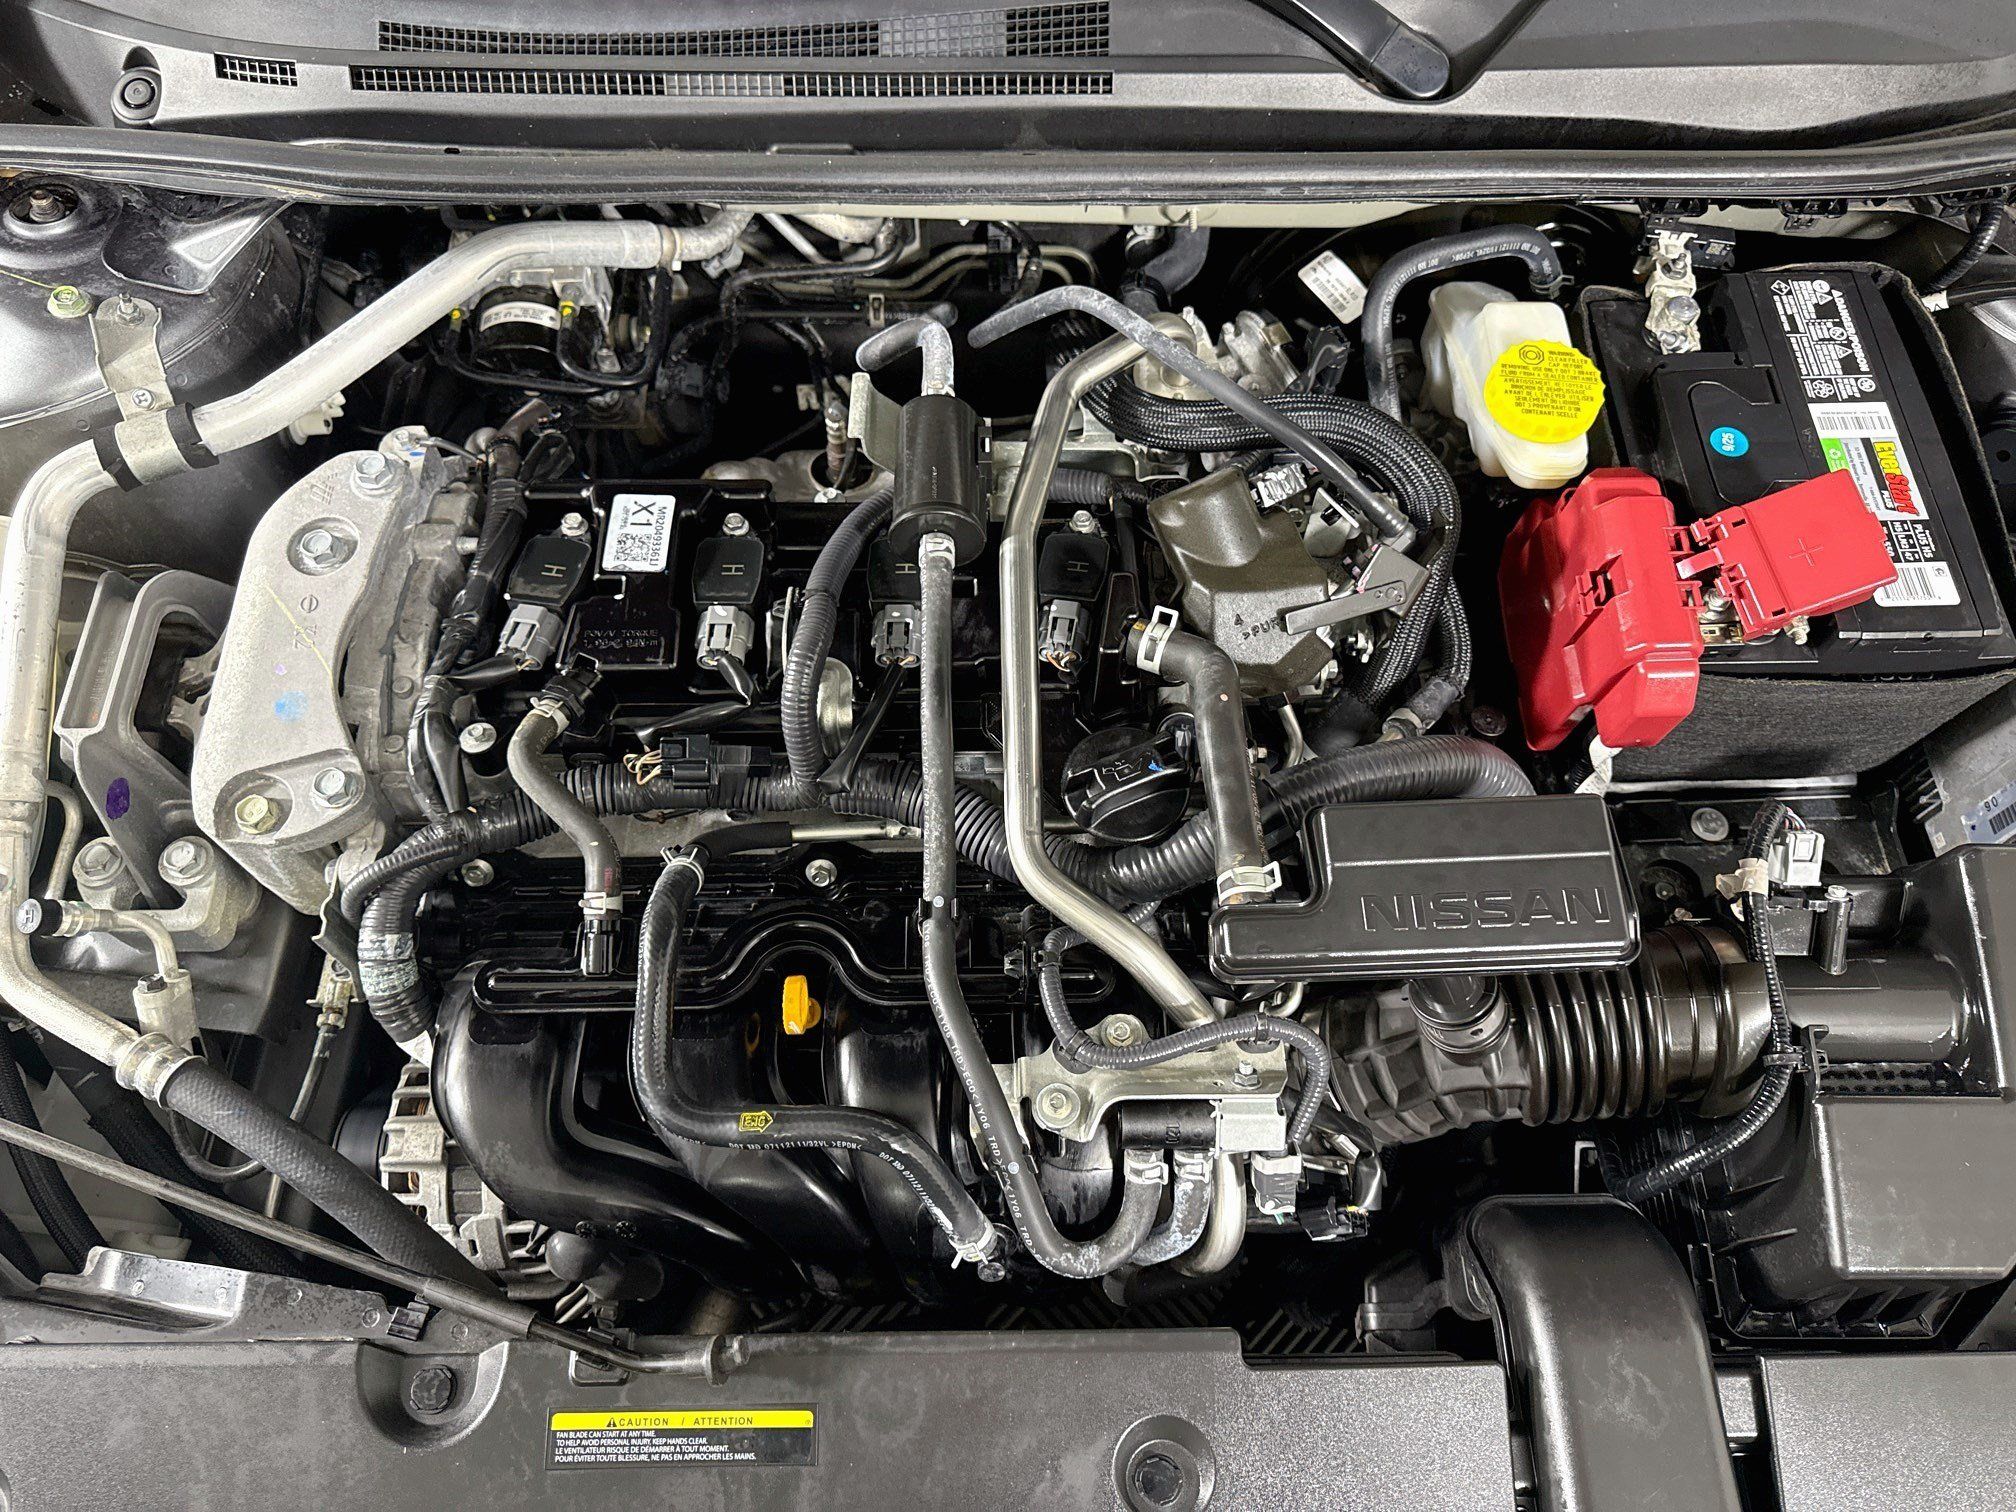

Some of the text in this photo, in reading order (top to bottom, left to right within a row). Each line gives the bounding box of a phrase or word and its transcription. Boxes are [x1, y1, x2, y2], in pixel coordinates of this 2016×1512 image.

[1873, 442, 1920, 516] EverStart
[1881, 490, 1895, 508] PLUS
[630, 500, 657, 526] X1
[1893, 522, 1904, 532] H5
[1913, 524, 1926, 546] PLUS
[1921, 547, 1933, 558] H5
[1361, 887, 1610, 931] NISSAN
[744, 1116, 766, 1127] ENG
[619, 1418, 669, 1427] CAUTION
[694, 1417, 754, 1426] ATTENTION
[600, 1438, 630, 1446] PERSONAL
[606, 1446, 630, 1454] RISQUE
[640, 1445, 674, 1453] DÉMARRER
[574, 1454, 595, 1462] ÉVITER
[618, 1454, 650, 1462] BLESSURE,
